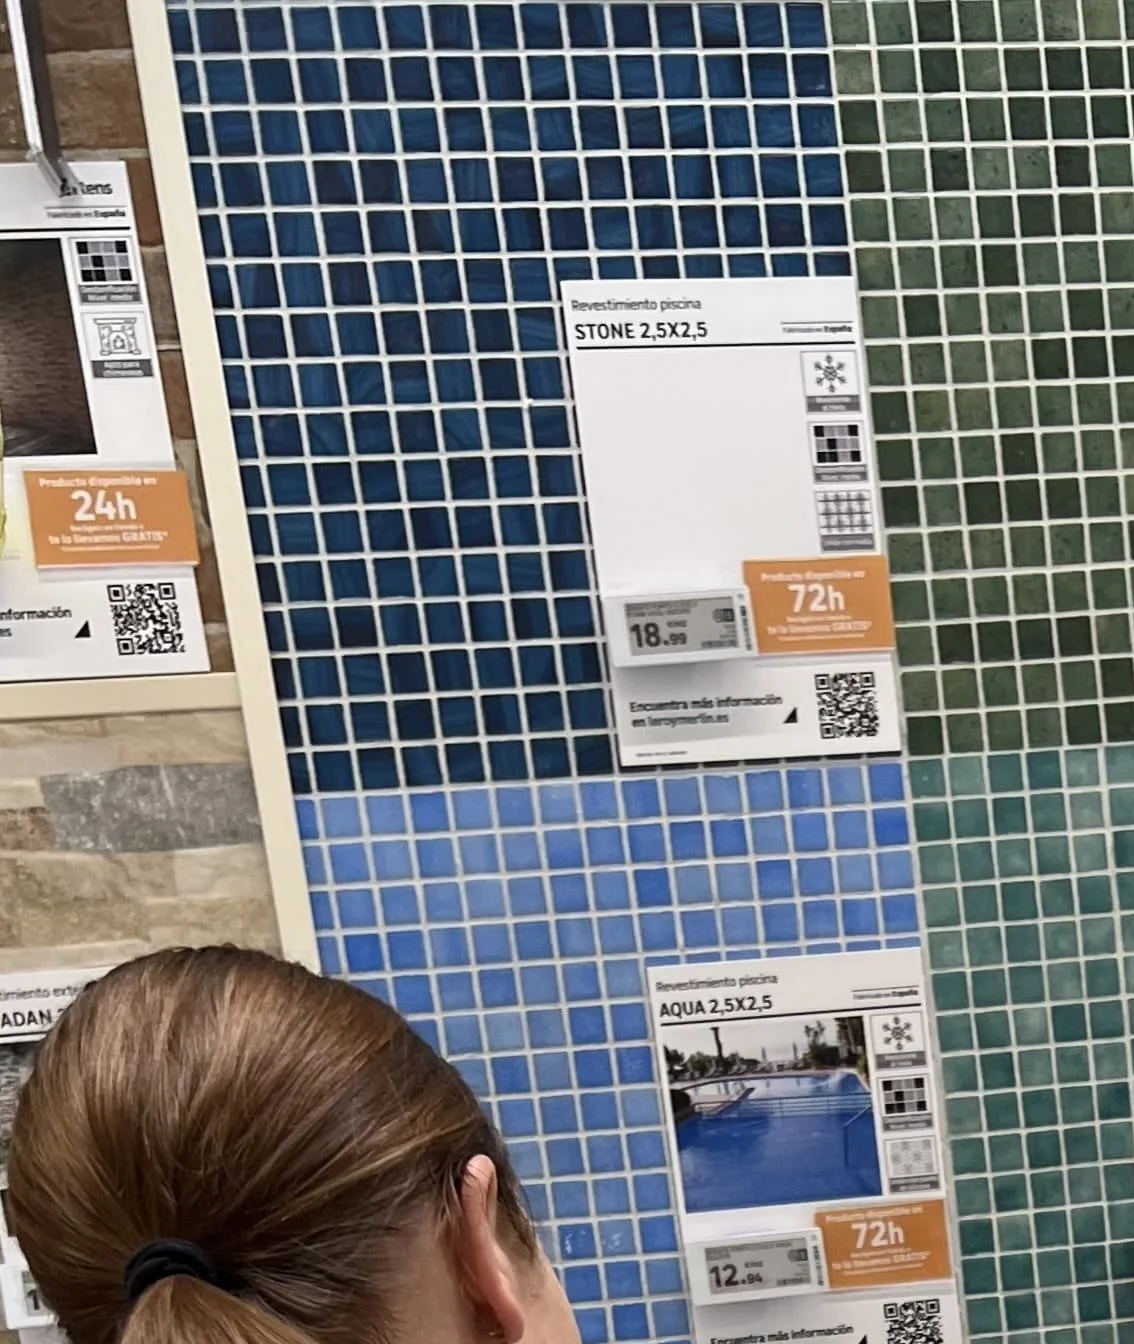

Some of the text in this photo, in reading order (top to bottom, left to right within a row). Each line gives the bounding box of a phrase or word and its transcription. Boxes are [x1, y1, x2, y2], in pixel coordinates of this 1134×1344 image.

[571, 298, 702, 312] Revestimiento piscina
[575, 321, 708, 342] STONE 2,5X2,5
[38, 478, 87, 488] Producto
[70, 490, 137, 522] 24h
[787, 584, 846, 613] 72h
[0, 606, 72, 621] nformación
[630, 622, 688, 648] 18.99
[630, 694, 784, 713] Encuentra más información
[656, 974, 778, 993] Revestimiento piscina
[660, 995, 773, 1018] AQUA 2,5X2,5
[851, 1221, 905, 1249] 72h
[767, 1330, 790, 1344] más
[791, 1325, 854, 1340] información
